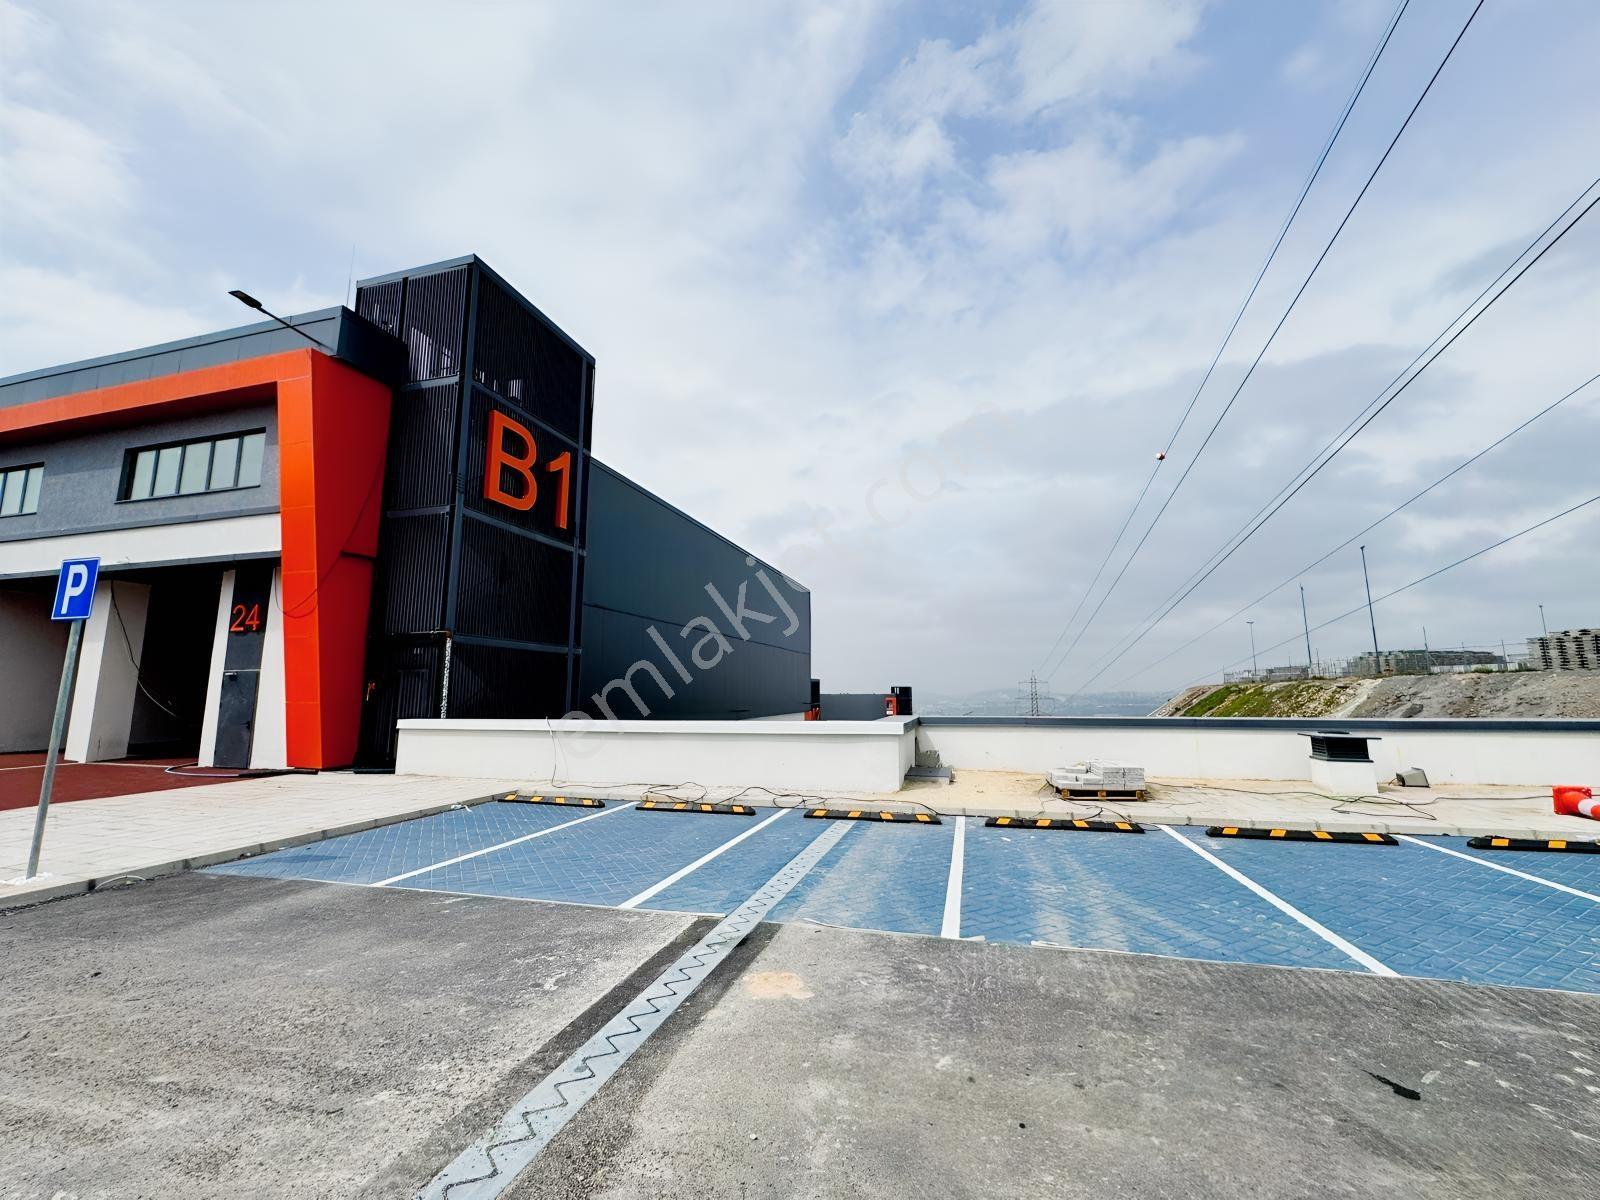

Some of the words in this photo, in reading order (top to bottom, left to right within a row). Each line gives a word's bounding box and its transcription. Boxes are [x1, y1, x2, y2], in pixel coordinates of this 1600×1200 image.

[484, 409, 571, 531] B1
[60, 563, 88, 615] P
[230, 604, 260, 632] 24
